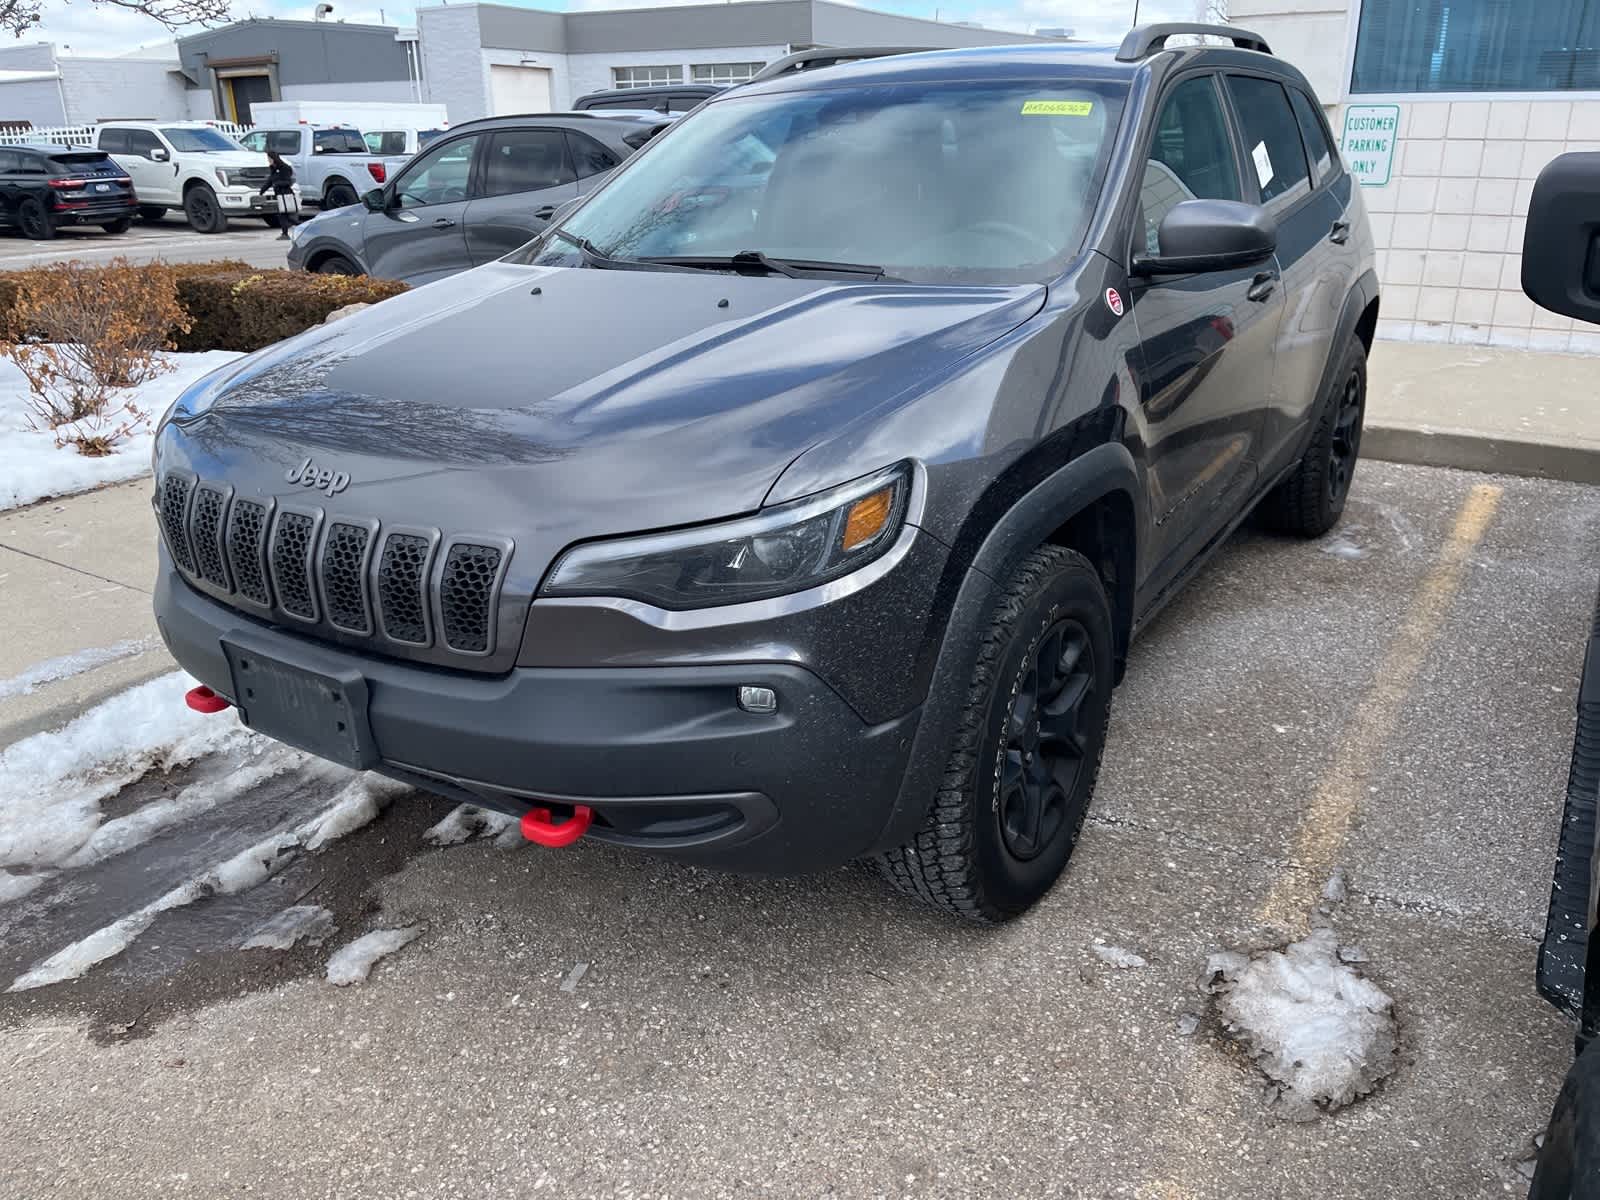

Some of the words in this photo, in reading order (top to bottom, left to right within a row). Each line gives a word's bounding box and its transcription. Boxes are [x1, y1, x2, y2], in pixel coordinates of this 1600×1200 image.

[1348, 117, 1394, 131] CUSTOMER
[1348, 139, 1387, 152] PARKING
[1352, 160, 1376, 174] ONLY
[285, 457, 352, 498] Jeep
